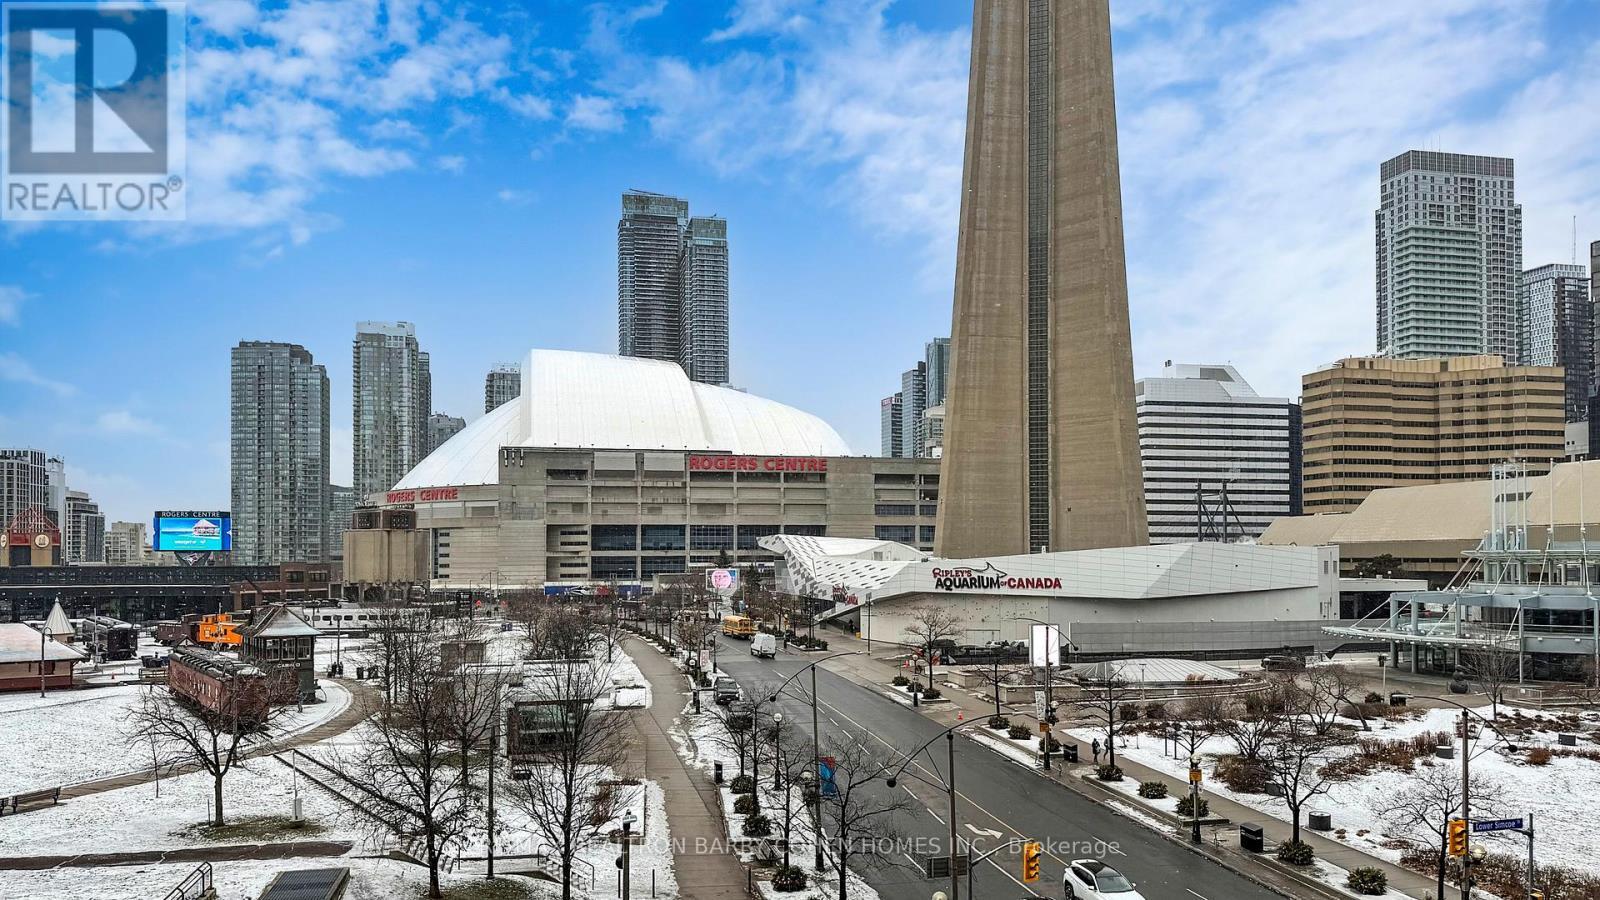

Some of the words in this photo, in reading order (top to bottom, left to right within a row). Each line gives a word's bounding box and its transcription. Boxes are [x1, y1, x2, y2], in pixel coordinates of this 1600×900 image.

[688, 455, 758, 471] ROGERS
[763, 457, 828, 472] CENTRE
[386, 491, 416, 503] ROGERS
[420, 488, 458, 501] CENTRE
[935, 575, 1001, 591] AQUARIUM
[1007, 577, 1062, 589] CANADA
